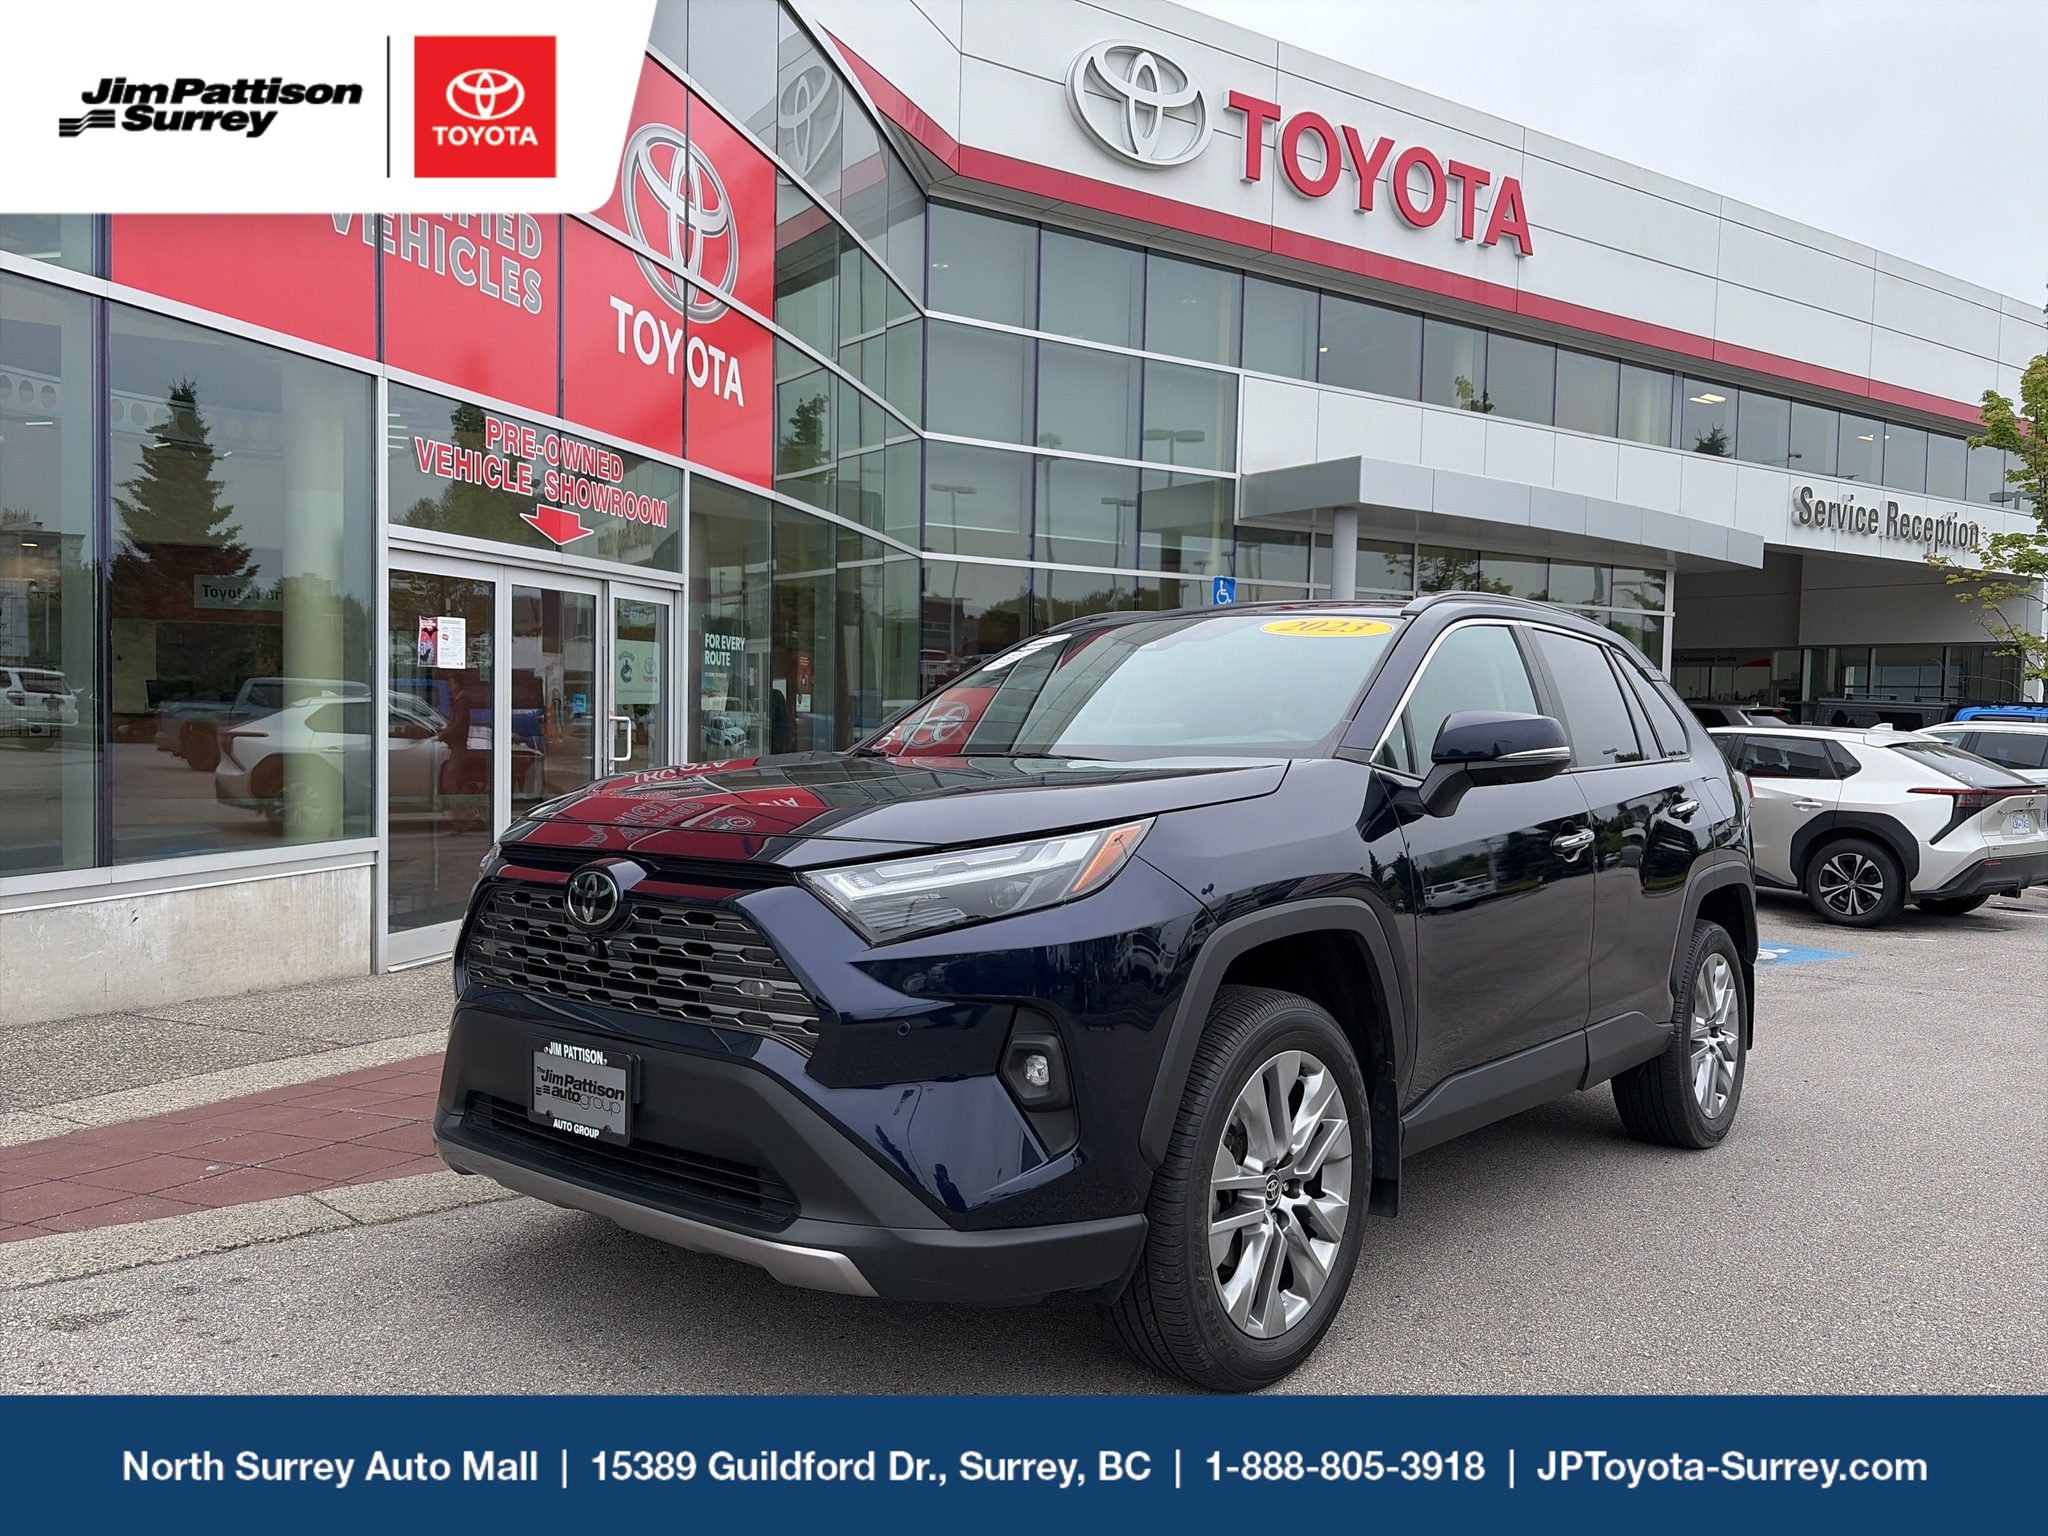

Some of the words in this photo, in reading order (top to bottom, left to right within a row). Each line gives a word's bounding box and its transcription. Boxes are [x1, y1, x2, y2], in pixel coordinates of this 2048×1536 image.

[1224, 89, 1534, 257] TOYOTA
[609, 294, 745, 408] TOYOTA
[485, 416, 624, 483] PRE-OWNED
[414, 436, 533, 496] VEHICLE
[544, 469, 668, 528] SHOWROOM
[1795, 486, 1880, 535] Service
[1885, 500, 1980, 553] Reception
[704, 632, 721, 649] FOR
[721, 634, 746, 652] EVERY
[1277, 621, 1373, 633] 2023
[704, 649, 731, 667] ROUTE
[548, 1041, 562, 1057] JIM
[563, 1044, 604, 1066] PATTISON
[553, 1118, 573, 1132] AUTO
[574, 1123, 600, 1139] GROUP
